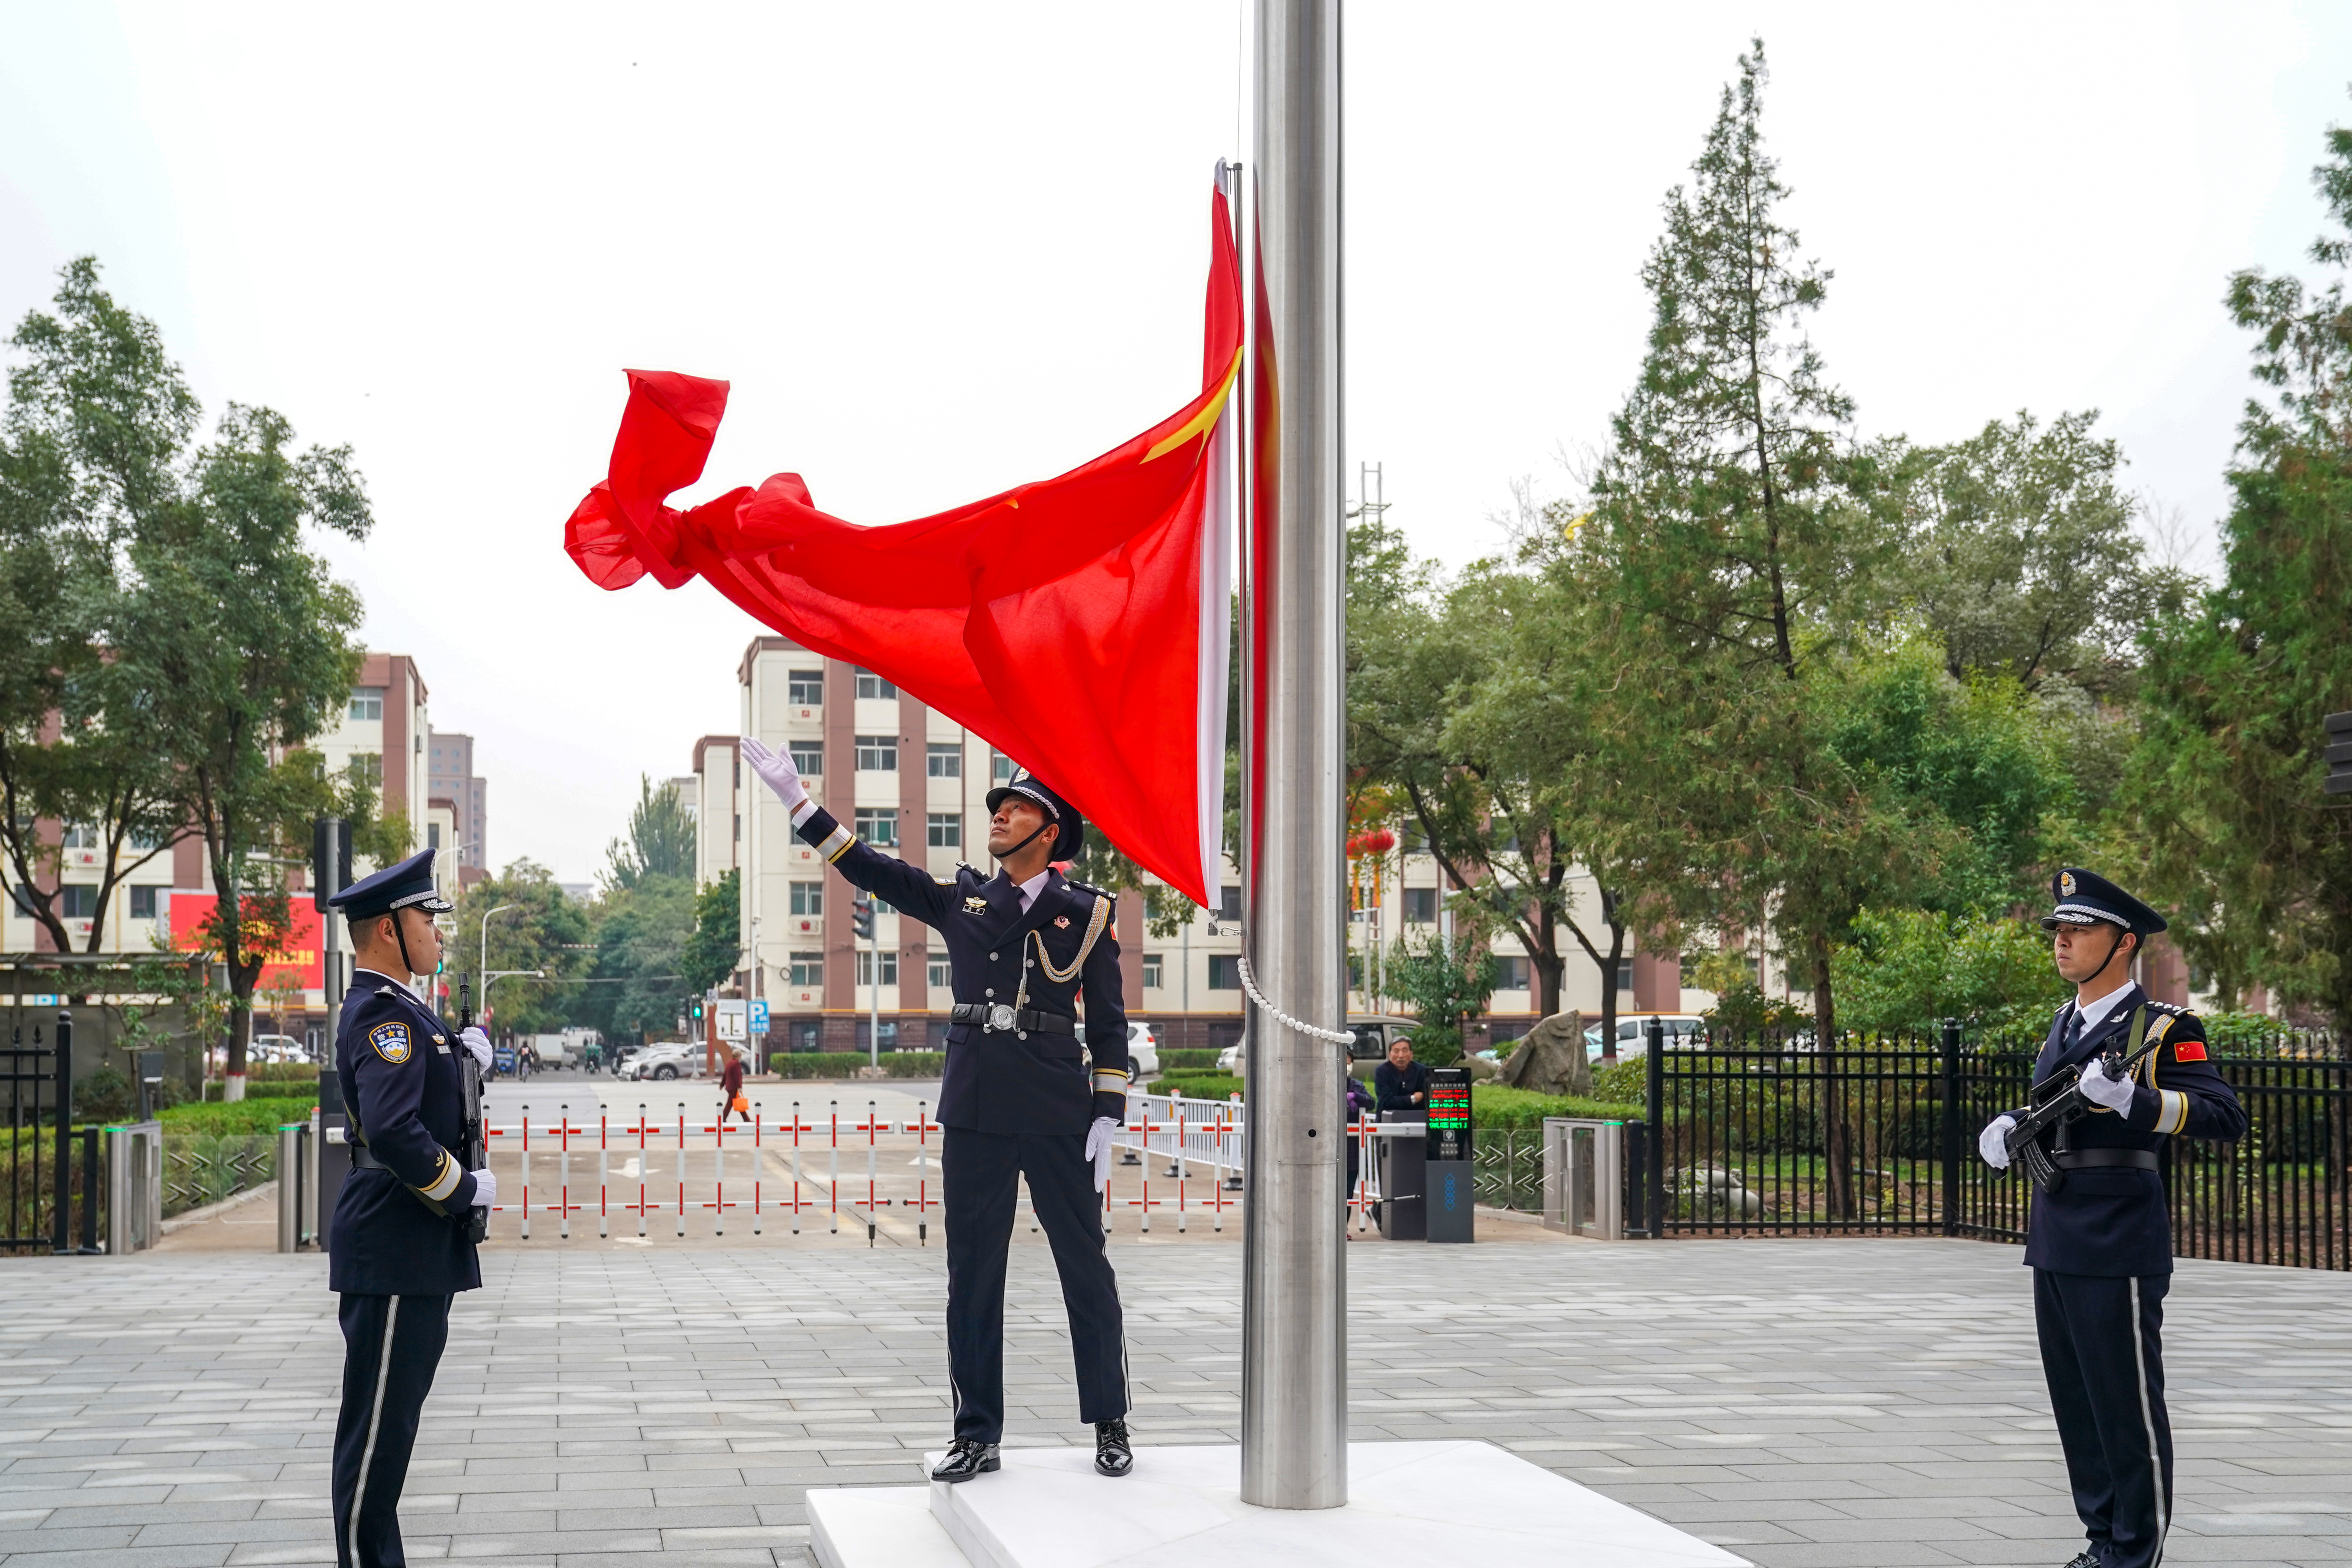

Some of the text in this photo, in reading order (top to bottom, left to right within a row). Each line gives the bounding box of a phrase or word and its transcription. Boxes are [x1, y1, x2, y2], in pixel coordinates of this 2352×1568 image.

[750, 1003, 765, 1022] P
[373, 1025, 405, 1036] 中华人民共和国
